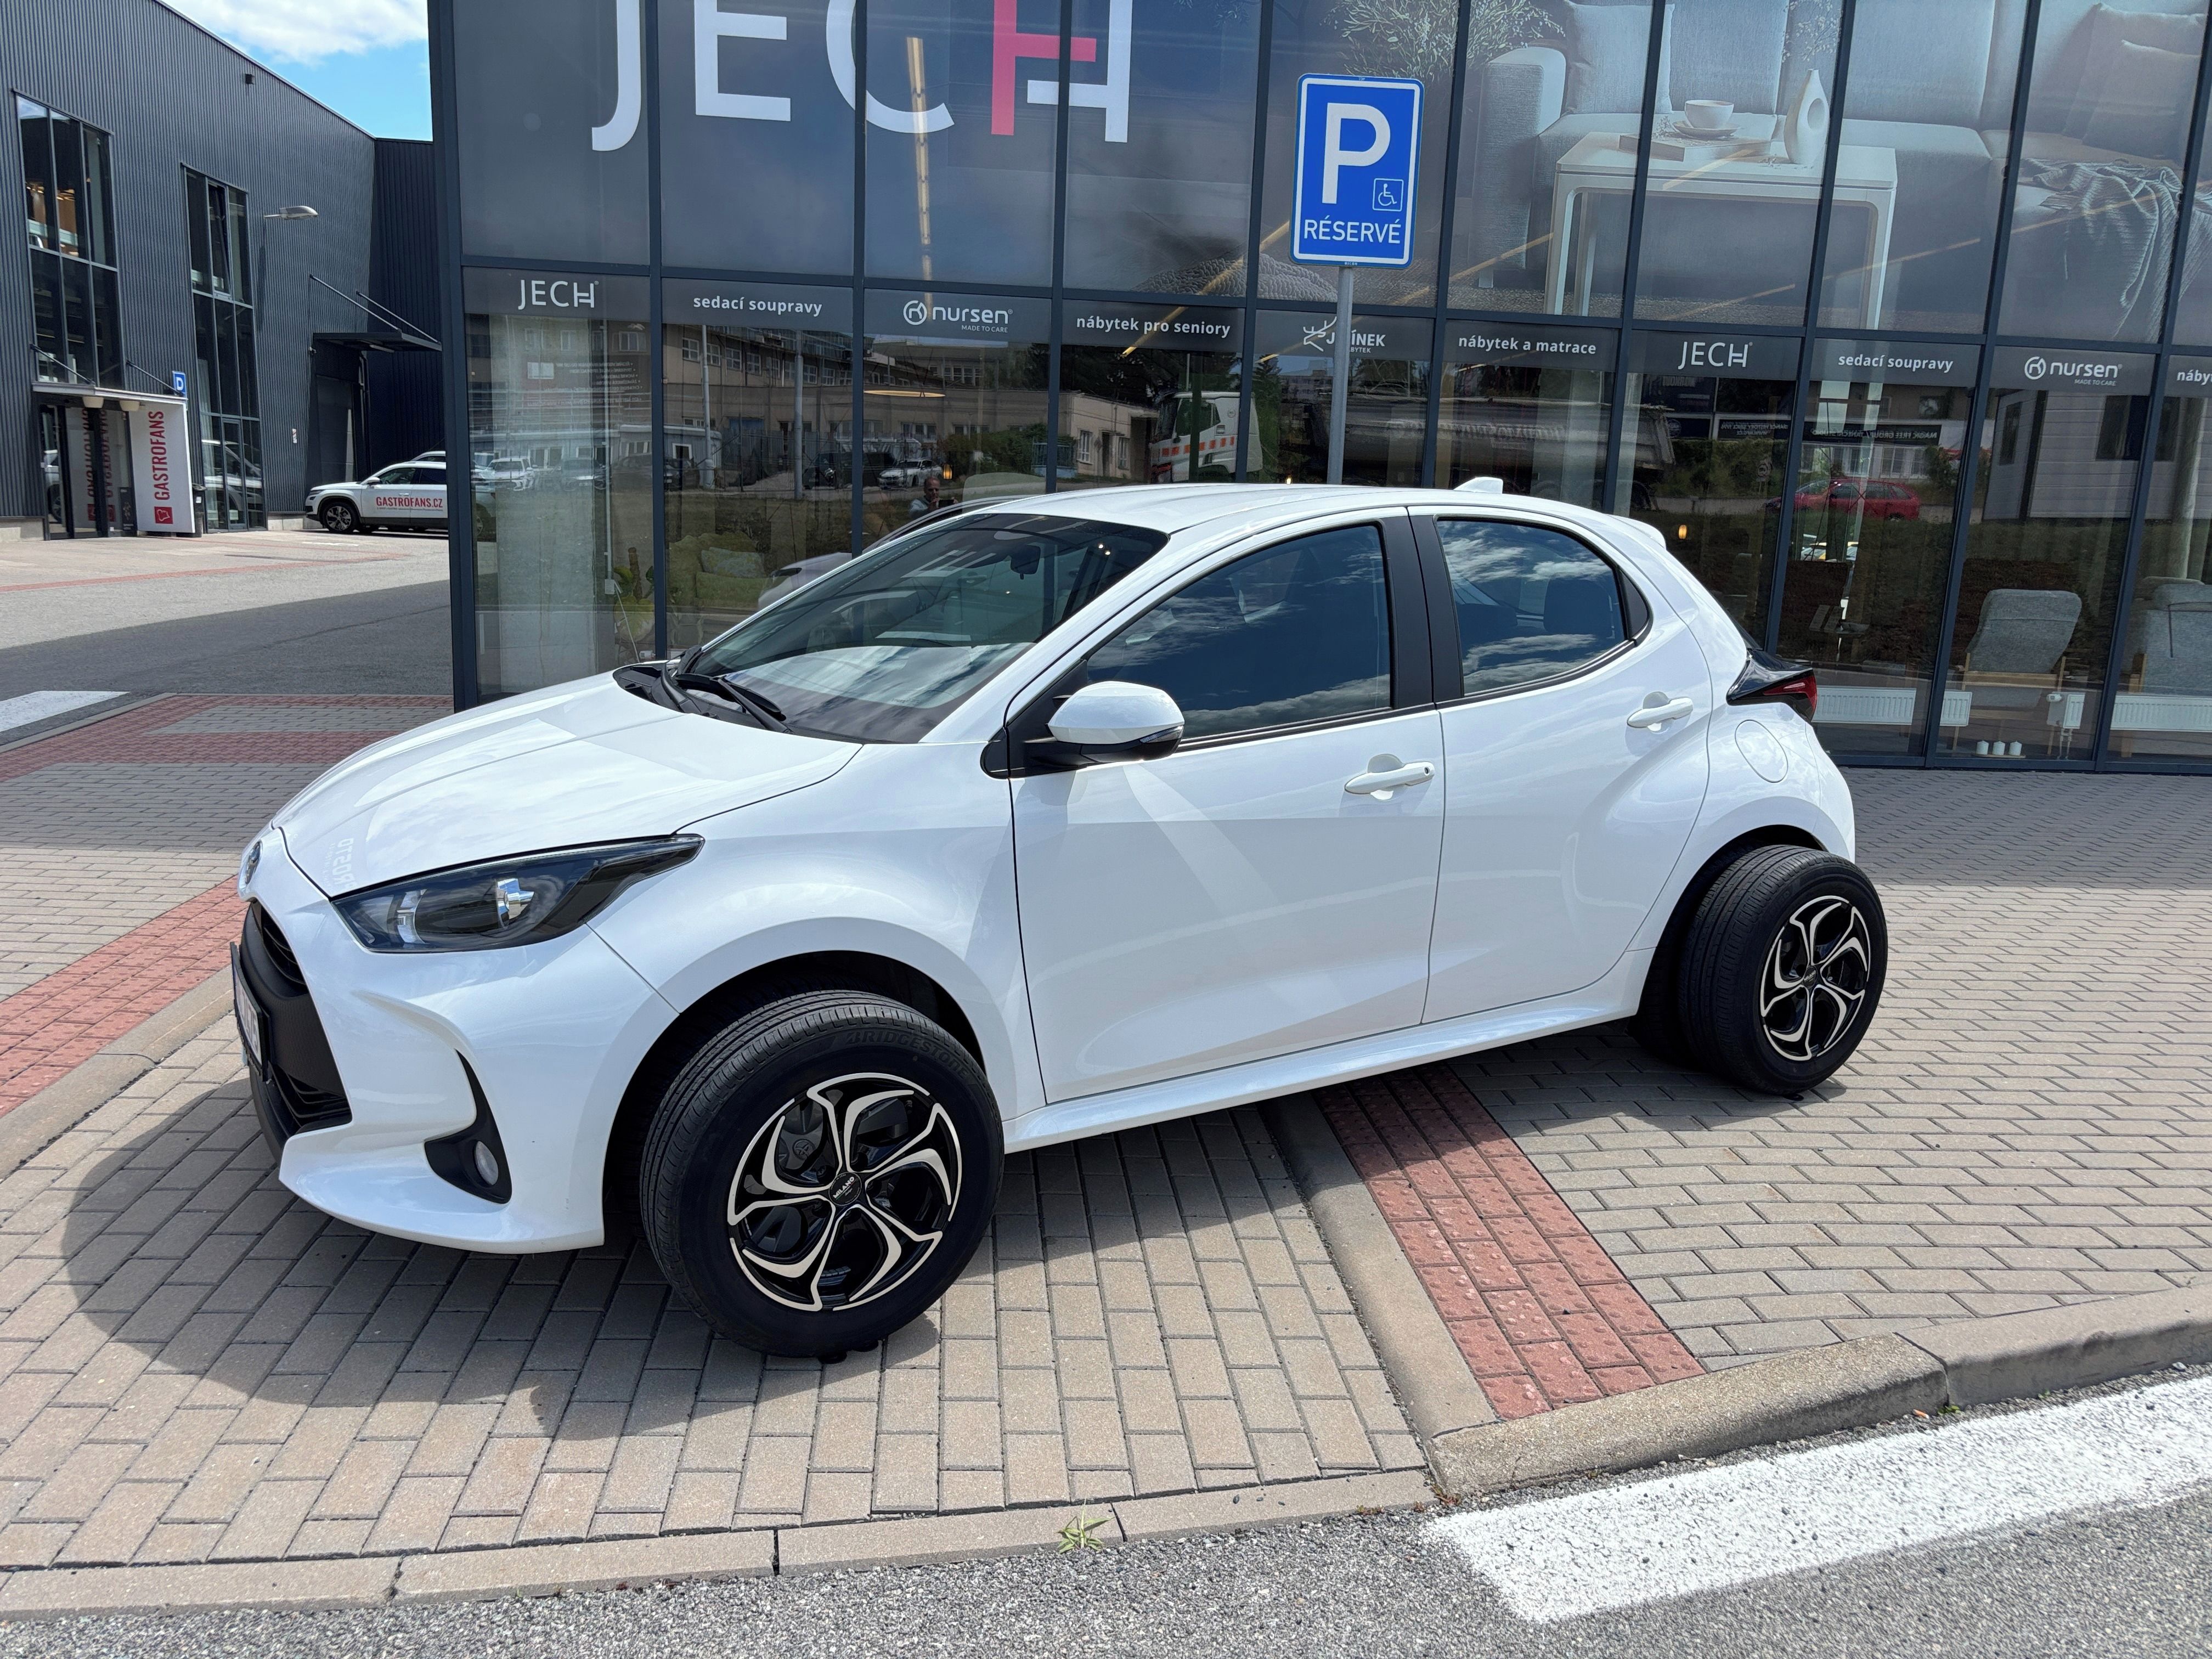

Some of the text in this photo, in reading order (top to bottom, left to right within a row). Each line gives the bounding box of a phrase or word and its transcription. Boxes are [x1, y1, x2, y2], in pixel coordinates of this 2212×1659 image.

[591, 0, 1132, 152] JECH
[1322, 103, 1391, 205] P
[1304, 215, 1401, 245] RÉSERVÉ
[693, 295, 822, 317] sedací soupravy
[1076, 315, 1231, 338] nábytek pro seniory
[1458, 335, 1596, 354] nábytek a matrace
[1838, 354, 1953, 373] sedací soupravy
[2176, 369, 2212, 386] náby
[148, 410, 171, 500] GASTROFANS
[376, 496, 443, 508] GASTROFANS.CZ
[845, 1031, 969, 1079] BRIDGESTONE
[833, 1176, 855, 1199] MILANO
